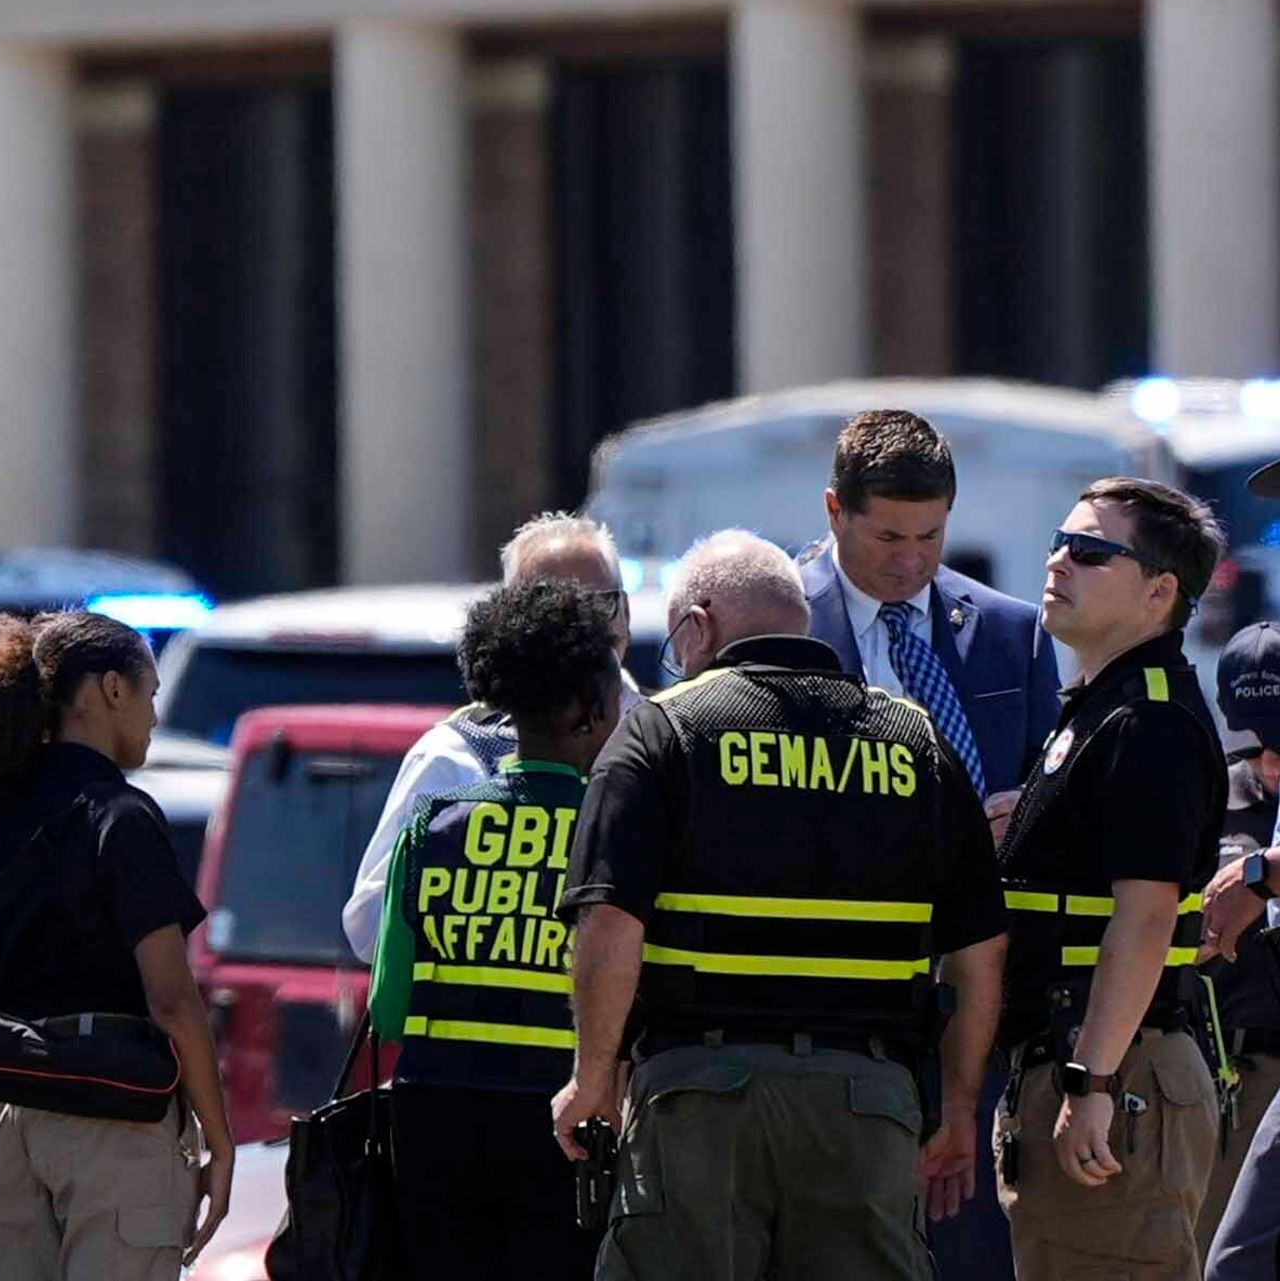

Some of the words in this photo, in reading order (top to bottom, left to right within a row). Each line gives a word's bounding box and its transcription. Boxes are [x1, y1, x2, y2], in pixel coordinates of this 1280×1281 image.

[720, 731, 916, 797] GEMA/HS
[464, 802, 577, 868] GBI
[418, 867, 566, 919] PUBLI
